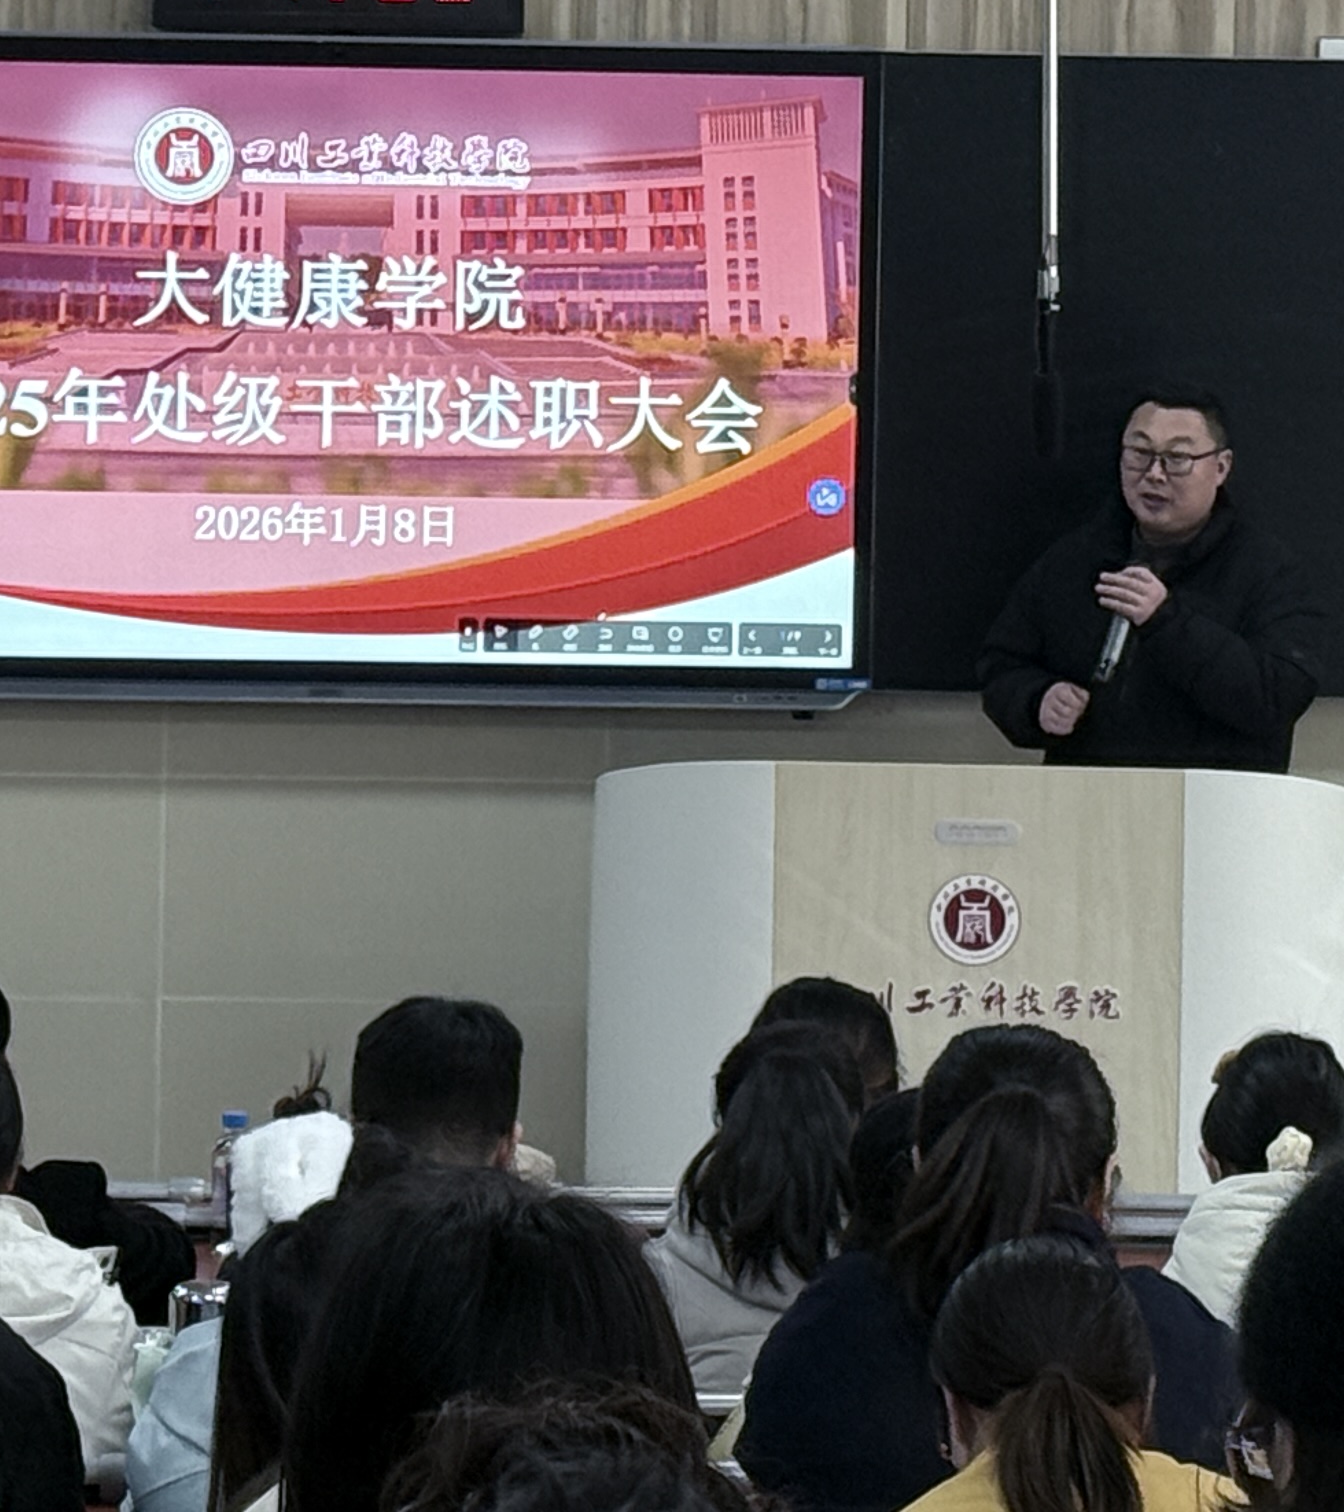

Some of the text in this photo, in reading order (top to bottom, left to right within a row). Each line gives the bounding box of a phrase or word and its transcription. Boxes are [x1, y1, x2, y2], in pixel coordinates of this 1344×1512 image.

[133, 249, 526, 331] 大健康学院
[194, 502, 455, 547] 2026年1月8日
